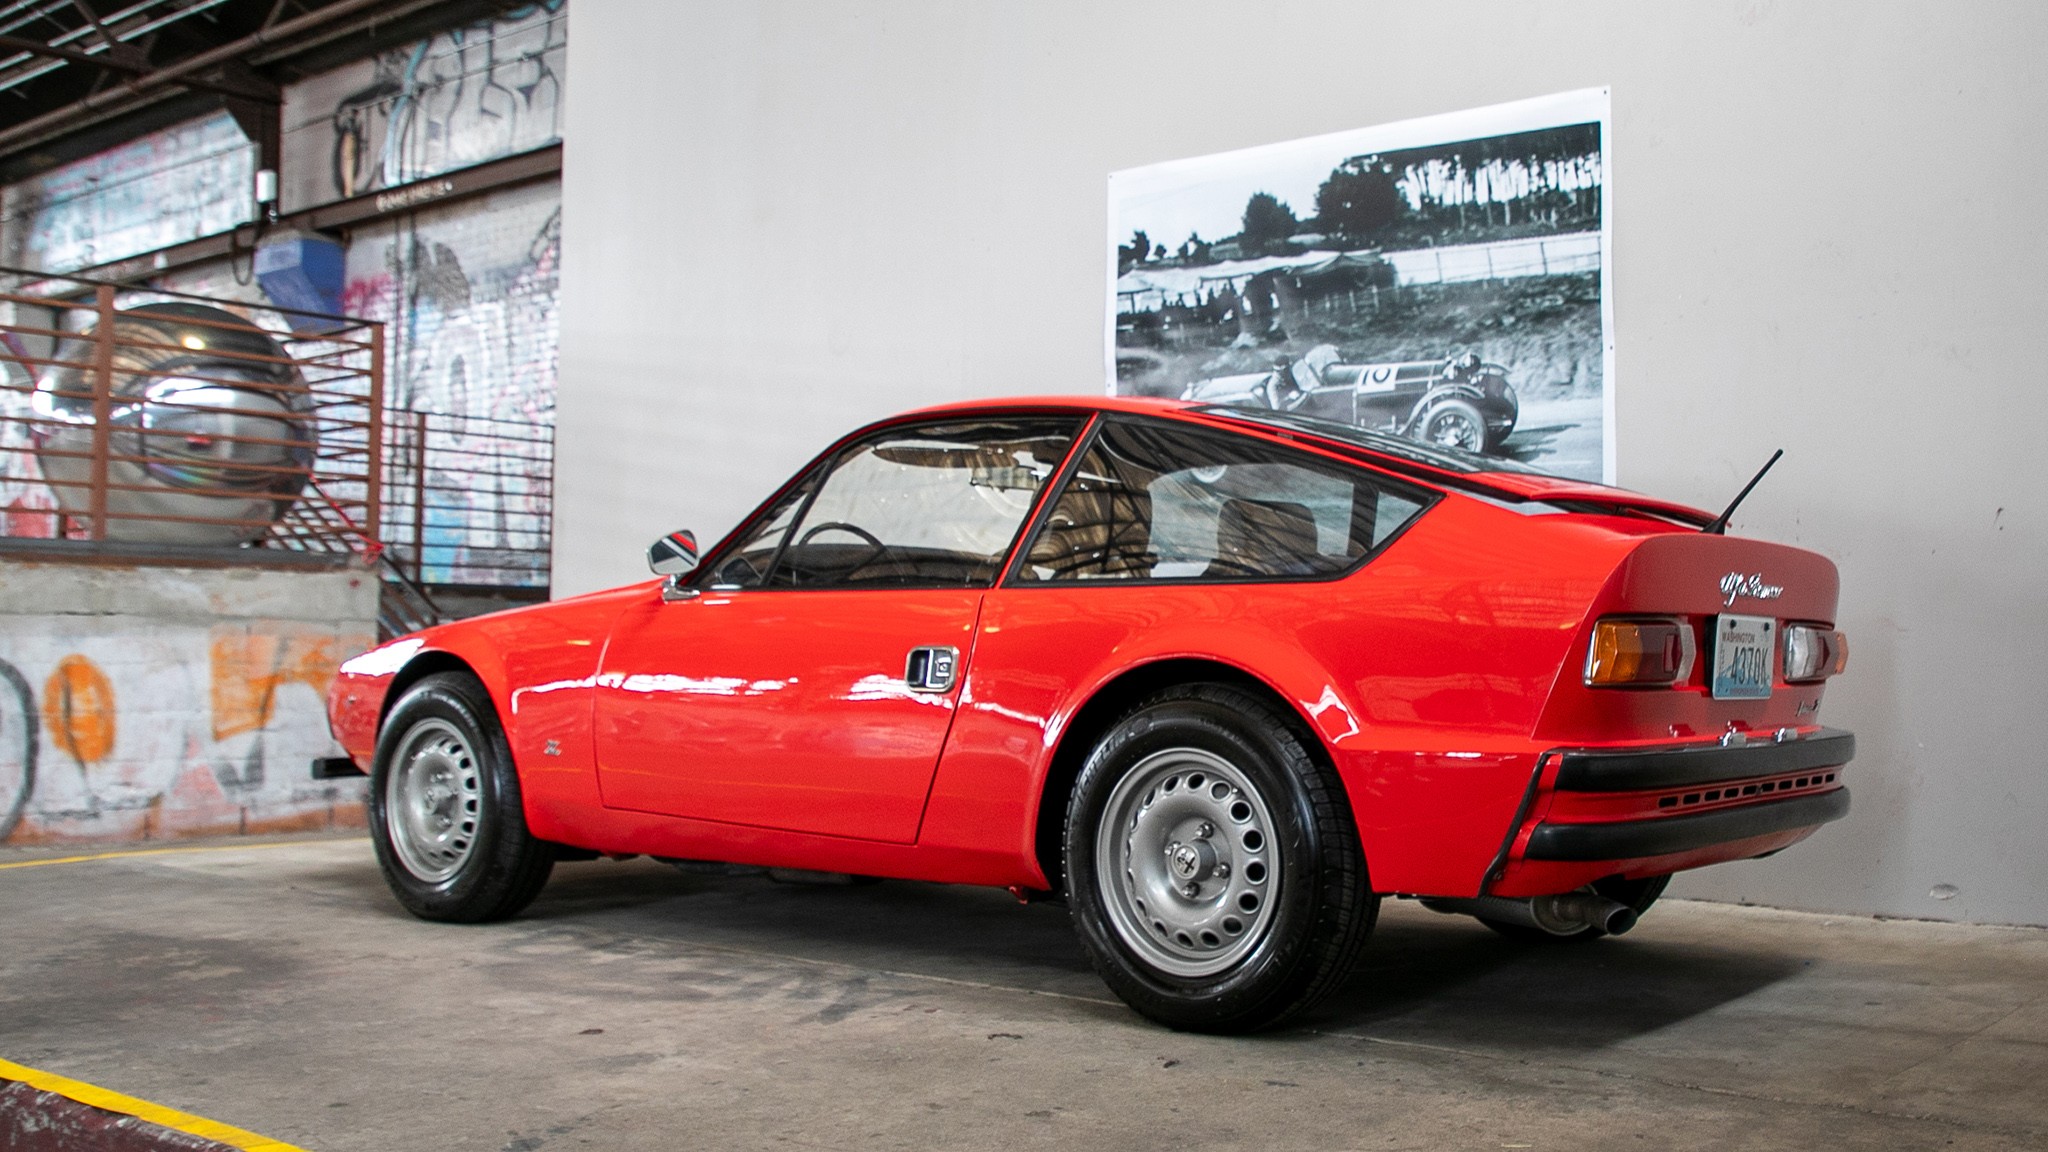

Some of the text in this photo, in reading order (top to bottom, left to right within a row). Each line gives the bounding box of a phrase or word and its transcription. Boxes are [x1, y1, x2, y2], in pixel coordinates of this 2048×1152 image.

[1362, 366, 1391, 386] 10
[1722, 631, 1755, 644] WASHINGTON
[1730, 646, 1769, 685] 4370K
